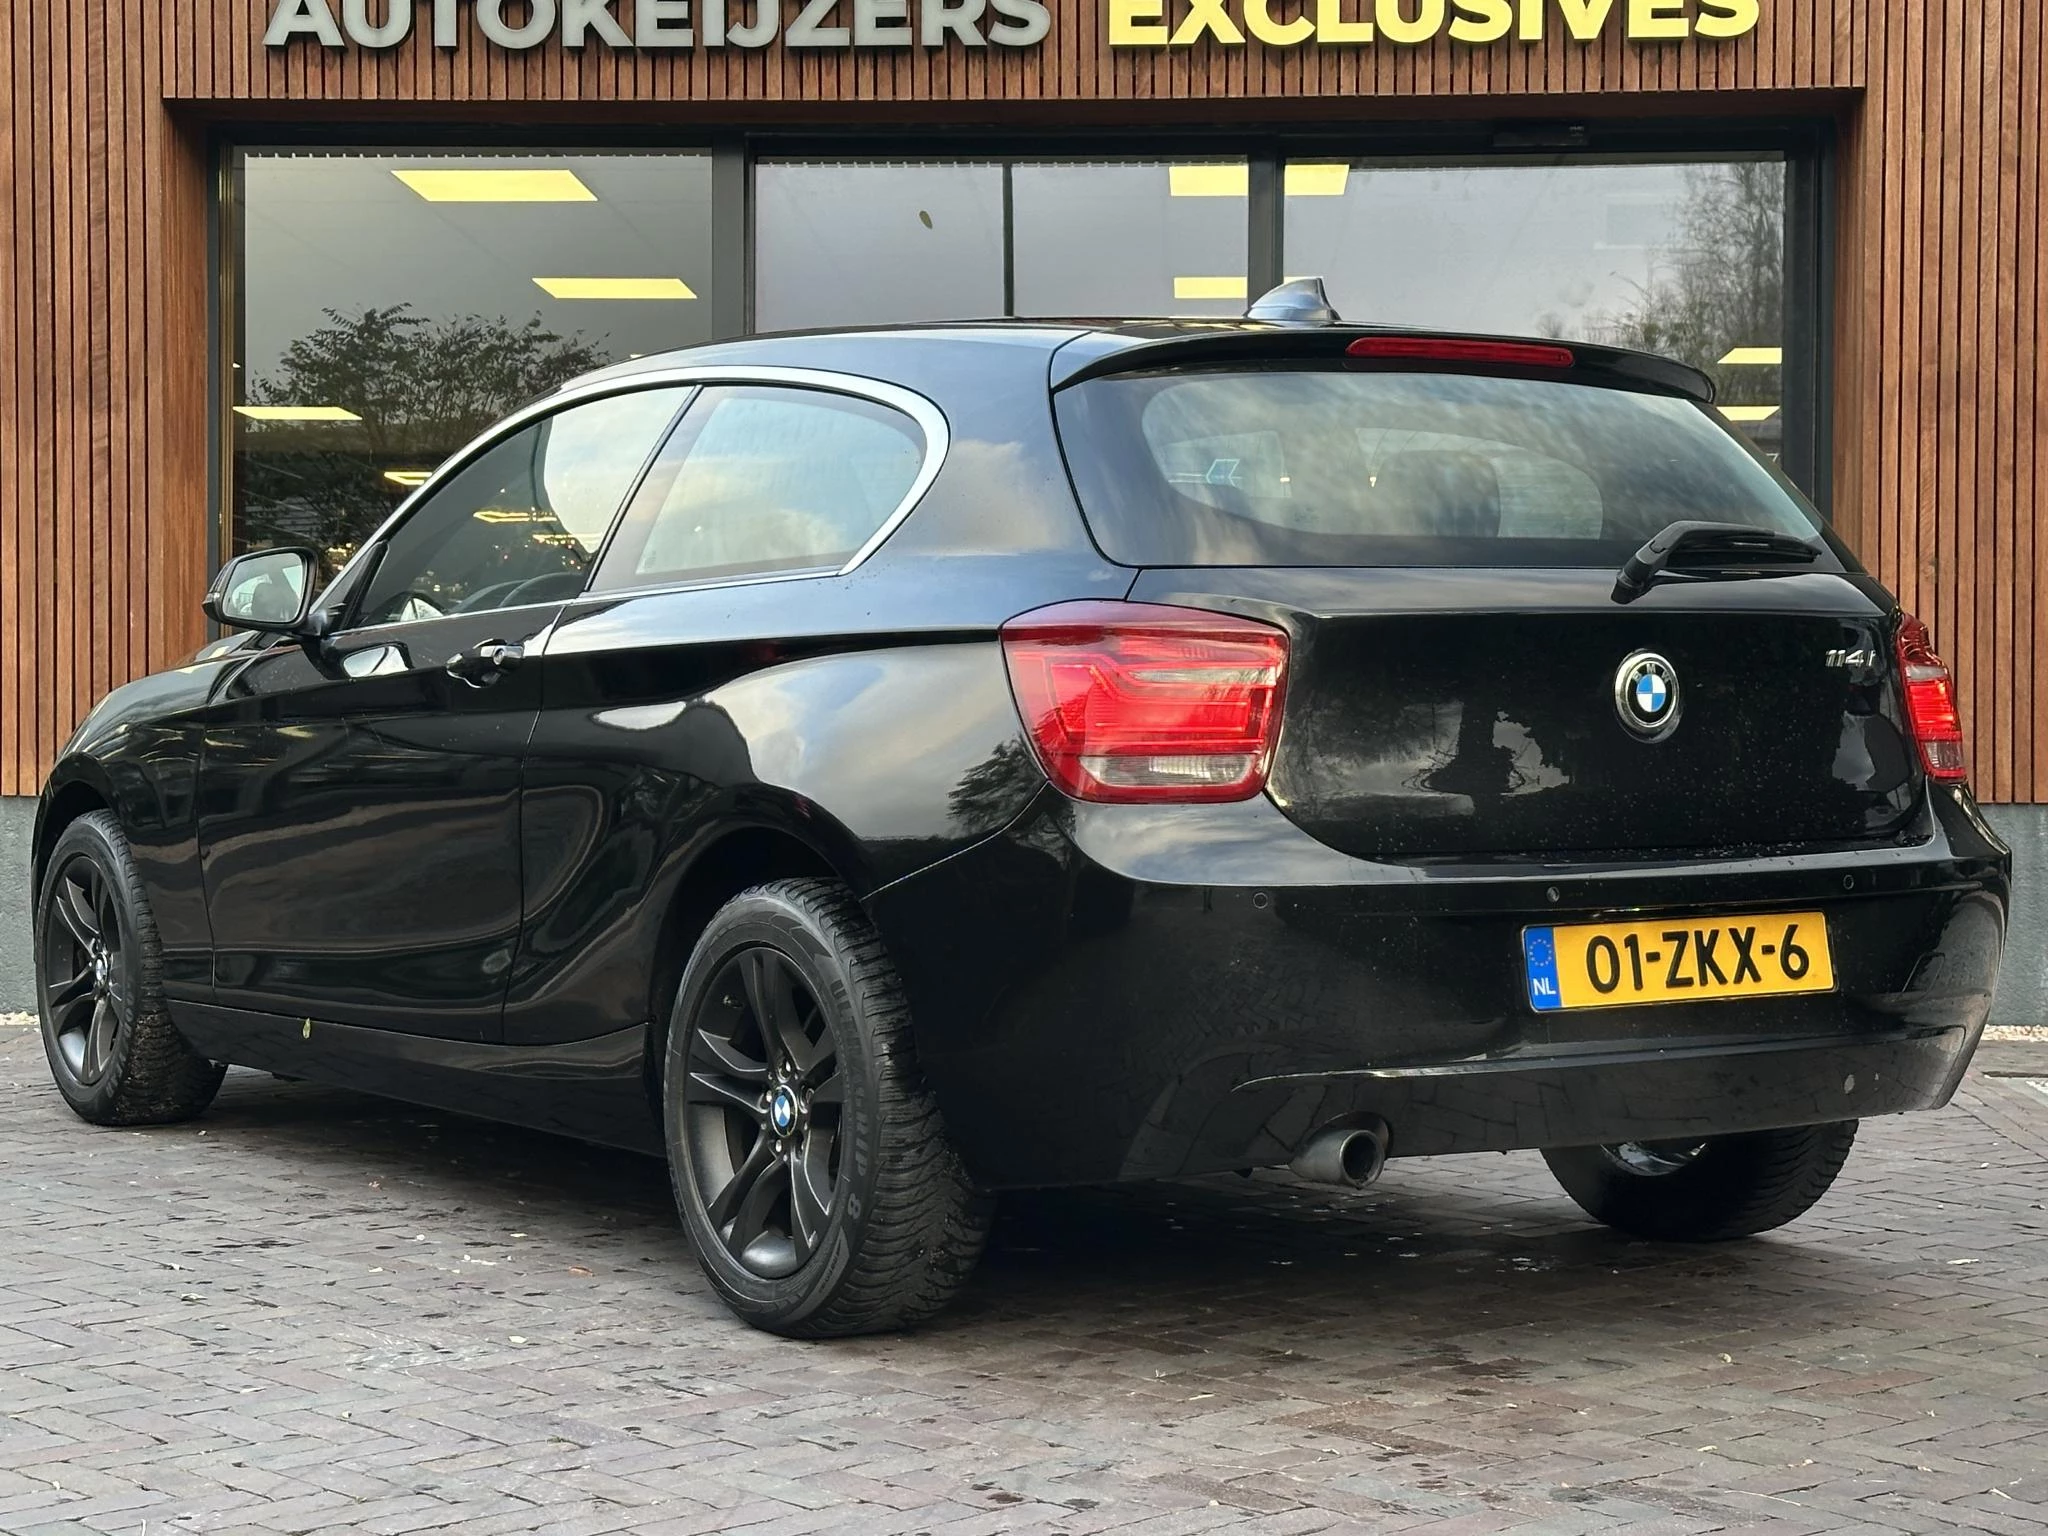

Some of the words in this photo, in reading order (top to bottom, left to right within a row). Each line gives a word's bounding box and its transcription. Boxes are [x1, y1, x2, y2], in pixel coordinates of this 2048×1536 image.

[262, 0, 1051, 49] AUTOKEIJZERS
[1108, 0, 1760, 46] EXCLUSIVES
[1632, 663, 1671, 684] BMW
[1586, 924, 1810, 994] 01-ZKX-6
[1533, 978, 1556, 996] NL
[847, 1192, 861, 1220] 8
